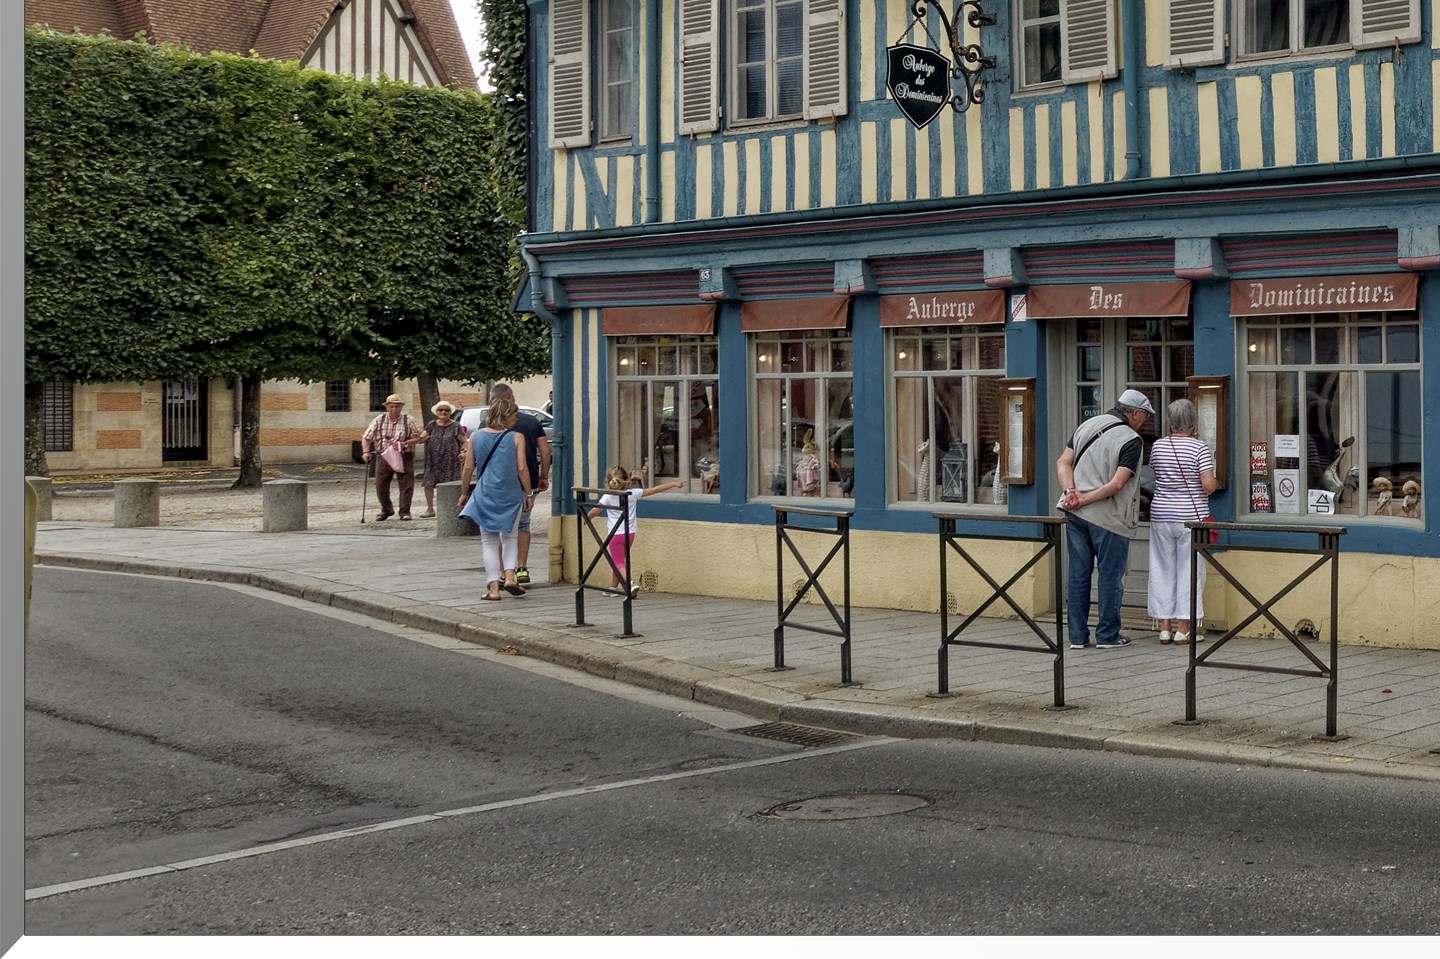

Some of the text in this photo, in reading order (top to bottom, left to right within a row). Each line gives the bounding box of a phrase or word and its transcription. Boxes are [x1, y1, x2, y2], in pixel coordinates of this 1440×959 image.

[903, 54, 935, 77] Auberge
[915, 74, 925, 85] des
[895, 82, 942, 103] Dominicaines
[906, 281, 1394, 323] Auberge Des Dominicaines
[1253, 485, 1266, 493] 2019
